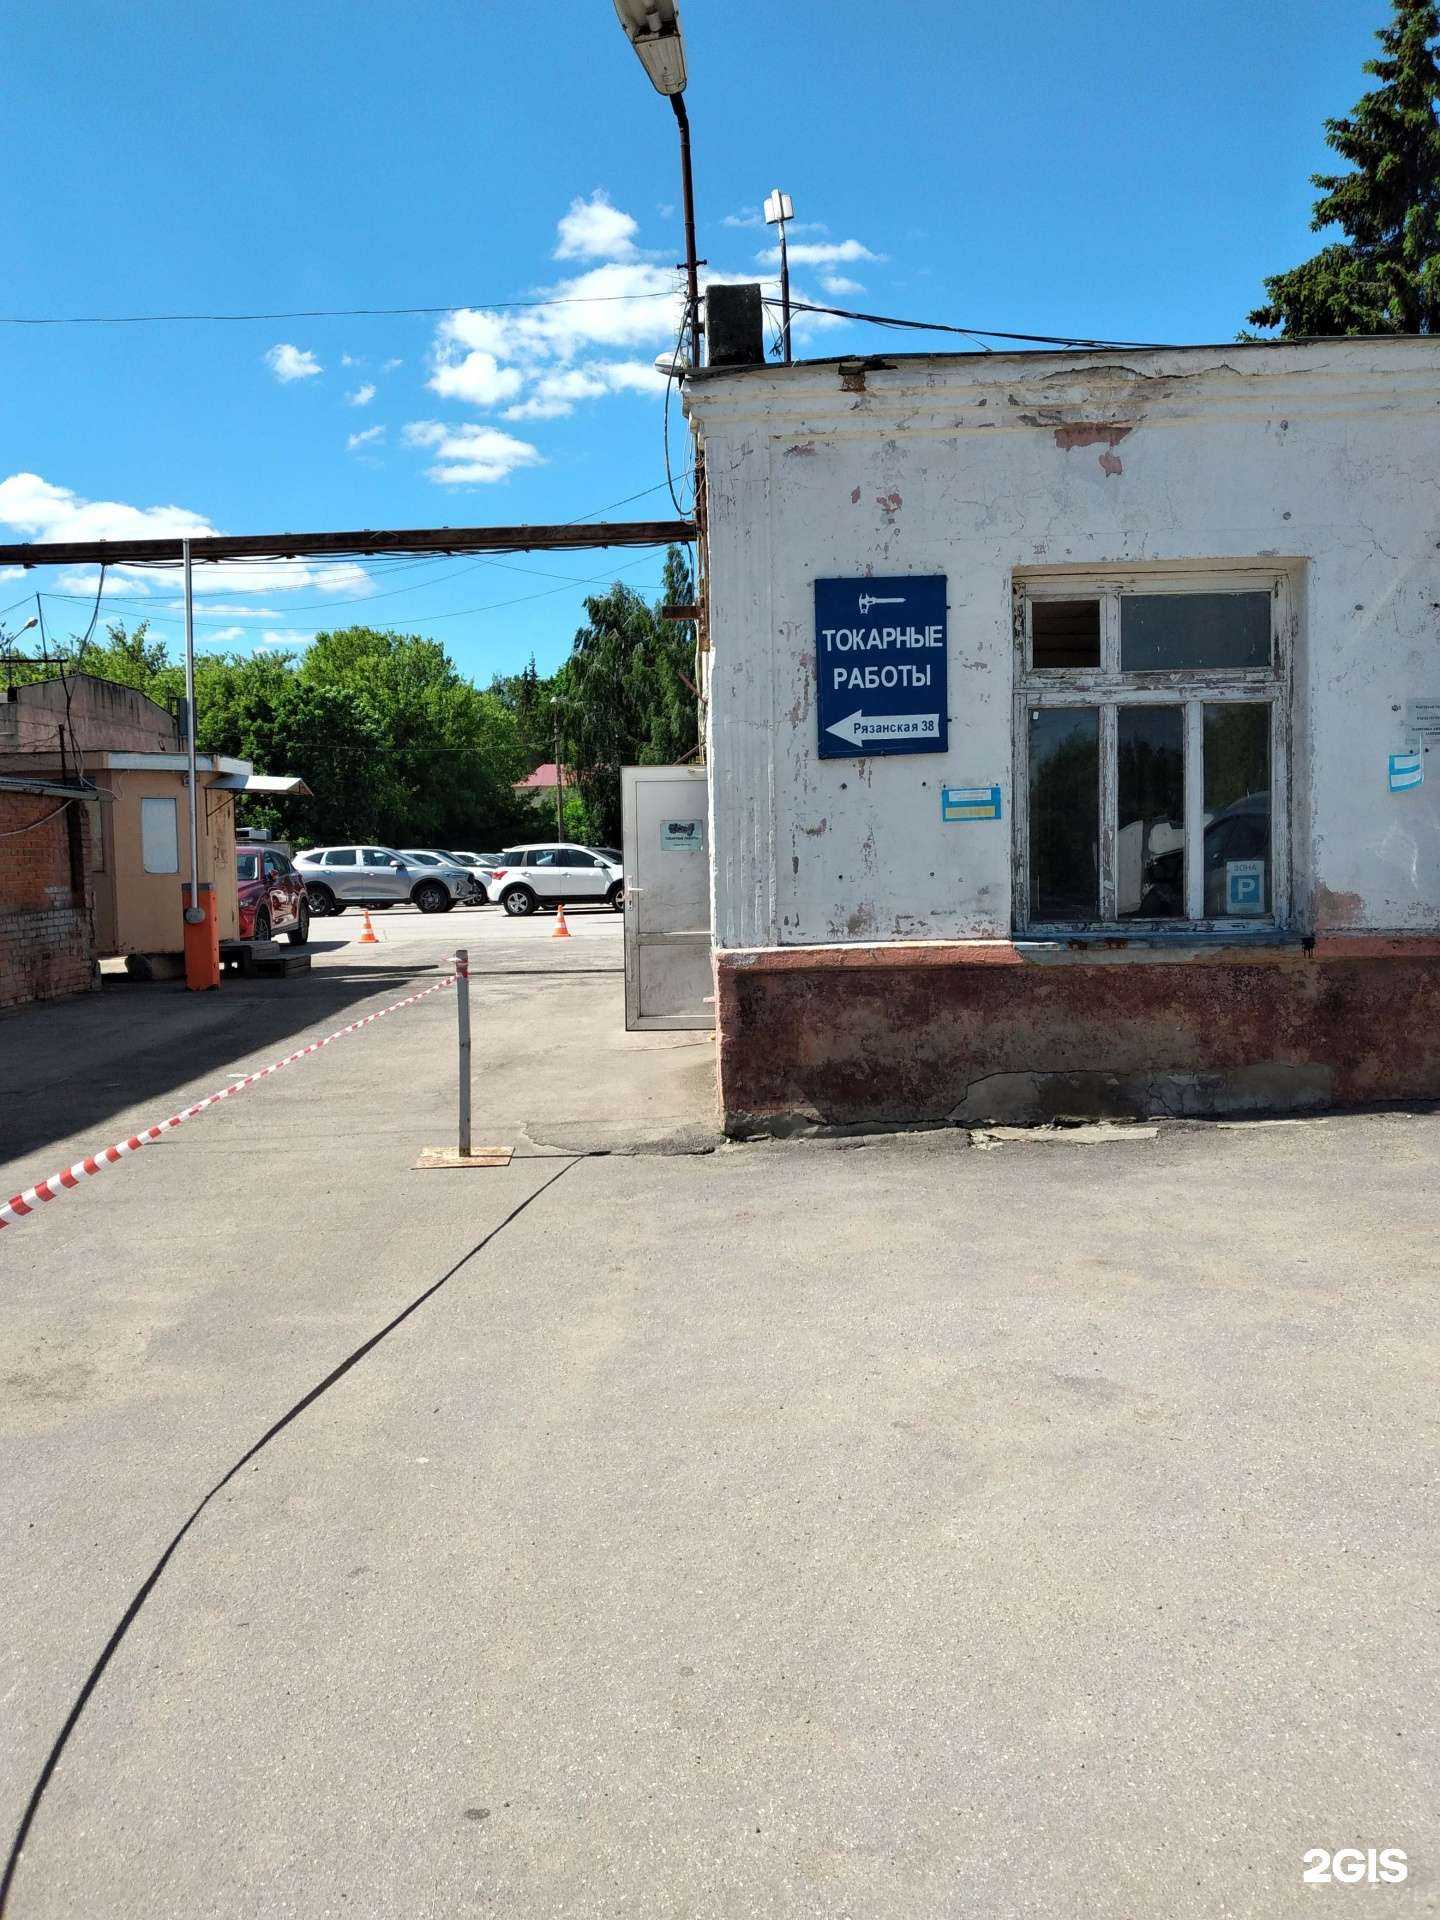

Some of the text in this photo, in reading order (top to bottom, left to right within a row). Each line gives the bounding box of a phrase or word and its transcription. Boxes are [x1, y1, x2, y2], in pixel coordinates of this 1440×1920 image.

[822, 625, 943, 651] ТОКАРНЫЕ
[833, 665, 931, 689] РАБОТЫ
[853, 720, 934, 734] Рязанская 38
